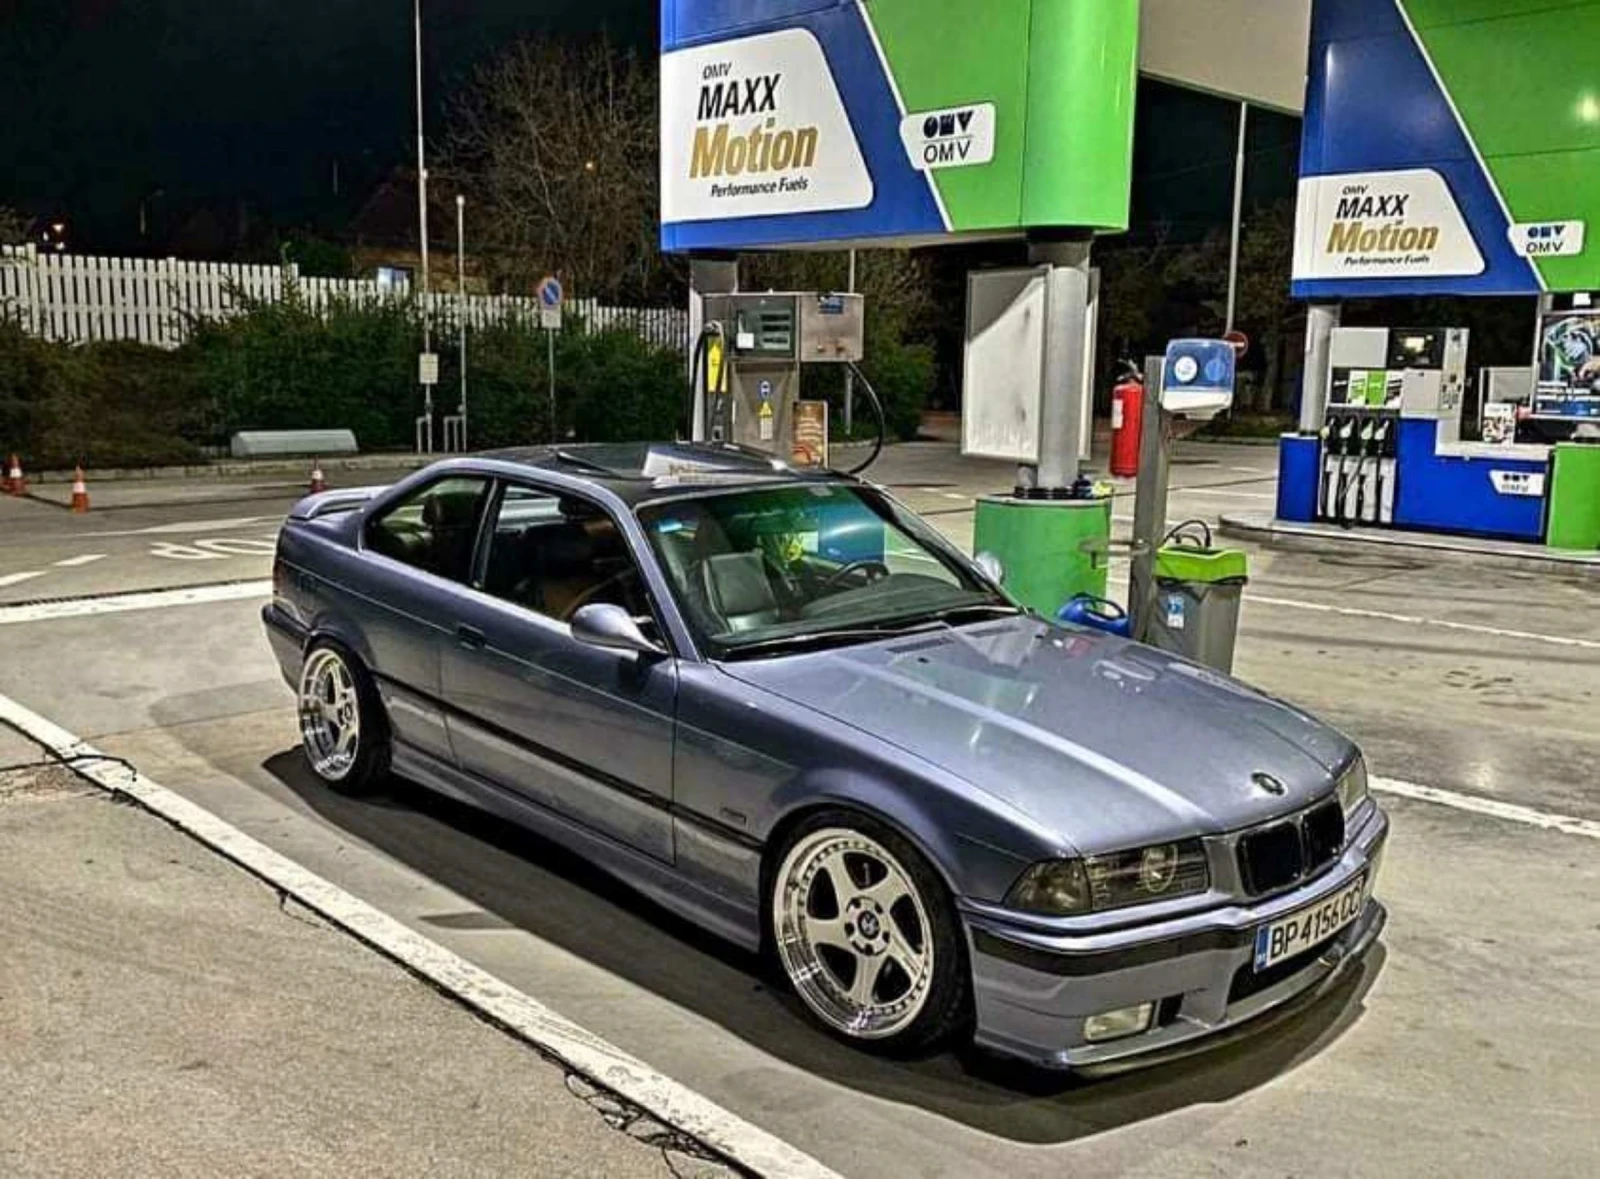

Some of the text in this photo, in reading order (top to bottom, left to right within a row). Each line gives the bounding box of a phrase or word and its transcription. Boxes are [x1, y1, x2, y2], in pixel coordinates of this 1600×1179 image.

[703, 62, 732, 80] OMV
[697, 73, 781, 121] MAXX
[924, 110, 974, 138] OMV
[689, 117, 818, 179] Motion
[924, 140, 970, 164] OMV
[711, 176, 808, 197] Performance Fuels
[1336, 194, 1410, 219] MAXX
[1327, 219, 1440, 253] Motion
[1525, 241, 1563, 254] OMV
[1271, 922, 1298, 959] BP
[1300, 899, 1339, 945] 4156
